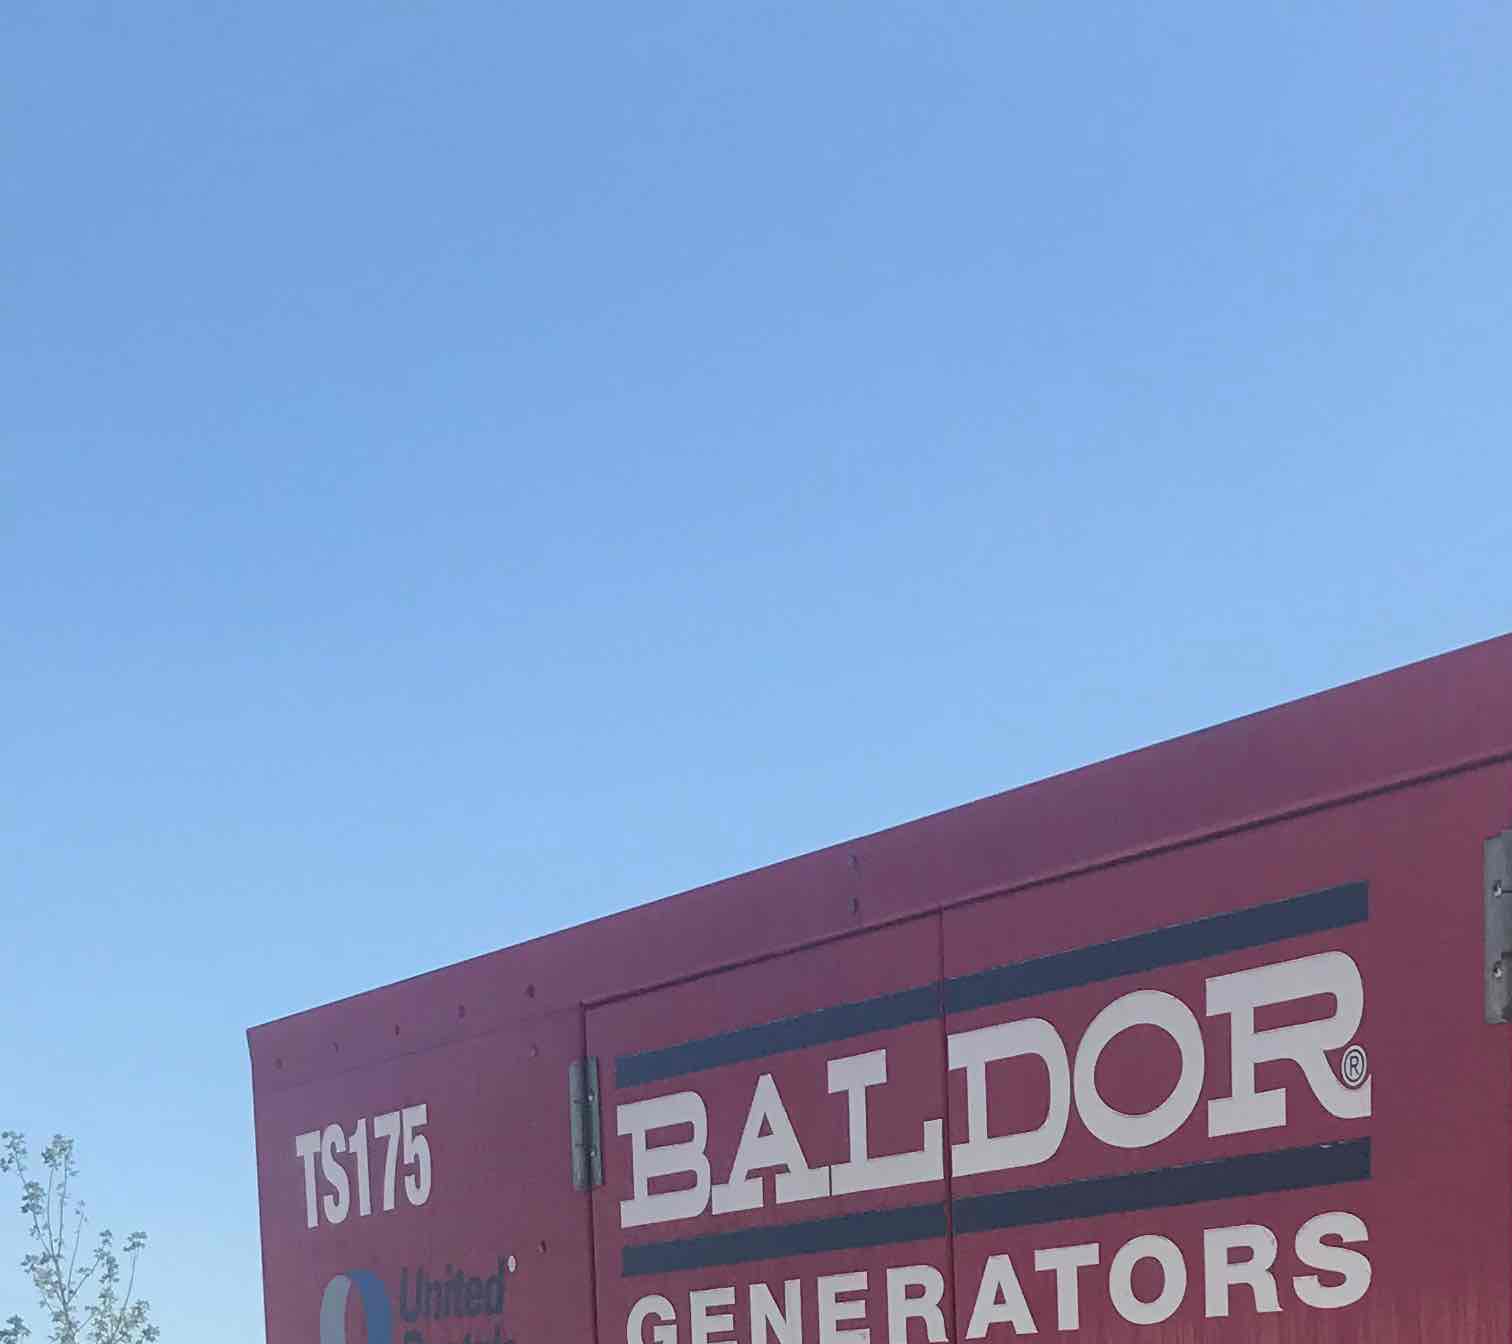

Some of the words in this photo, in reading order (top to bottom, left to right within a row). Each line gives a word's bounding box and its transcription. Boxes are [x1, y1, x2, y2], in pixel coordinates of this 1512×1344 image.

[616, 951, 1371, 1228] BALDOR
[296, 1104, 432, 1229] TS175
[401, 1257, 505, 1321] United
